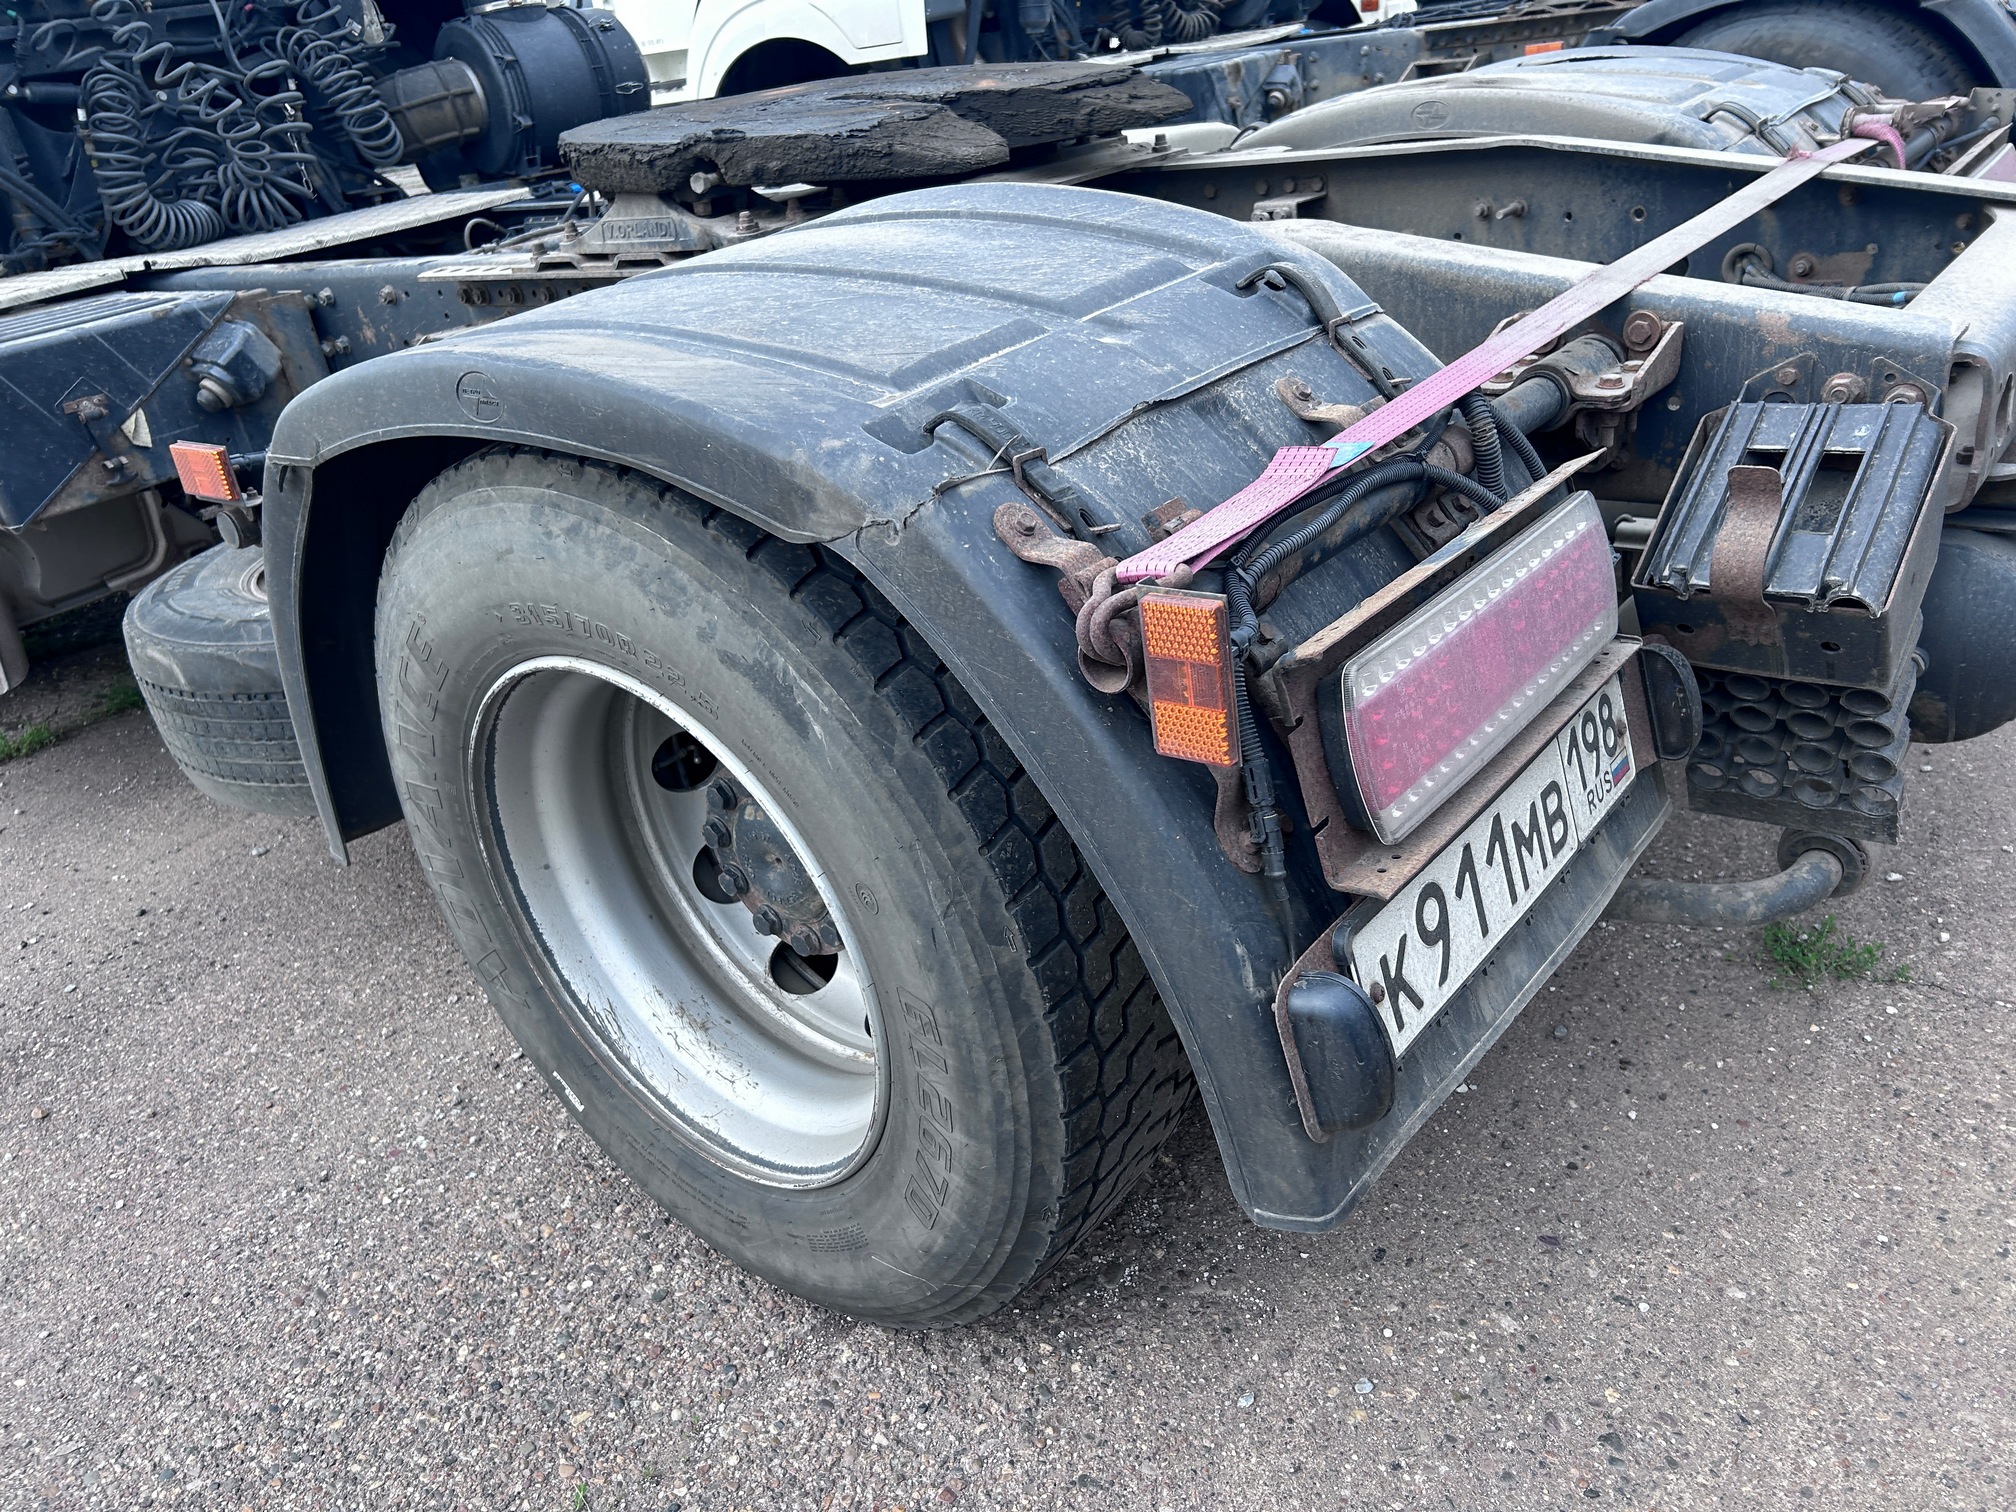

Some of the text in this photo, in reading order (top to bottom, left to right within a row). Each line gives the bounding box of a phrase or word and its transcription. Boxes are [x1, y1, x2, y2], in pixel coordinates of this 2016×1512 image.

[394, 621, 531, 1009] ADVANCE
[1566, 692, 1618, 792] 198
[1586, 770, 1614, 815] RUS
[896, 986, 954, 1231] GL267D
